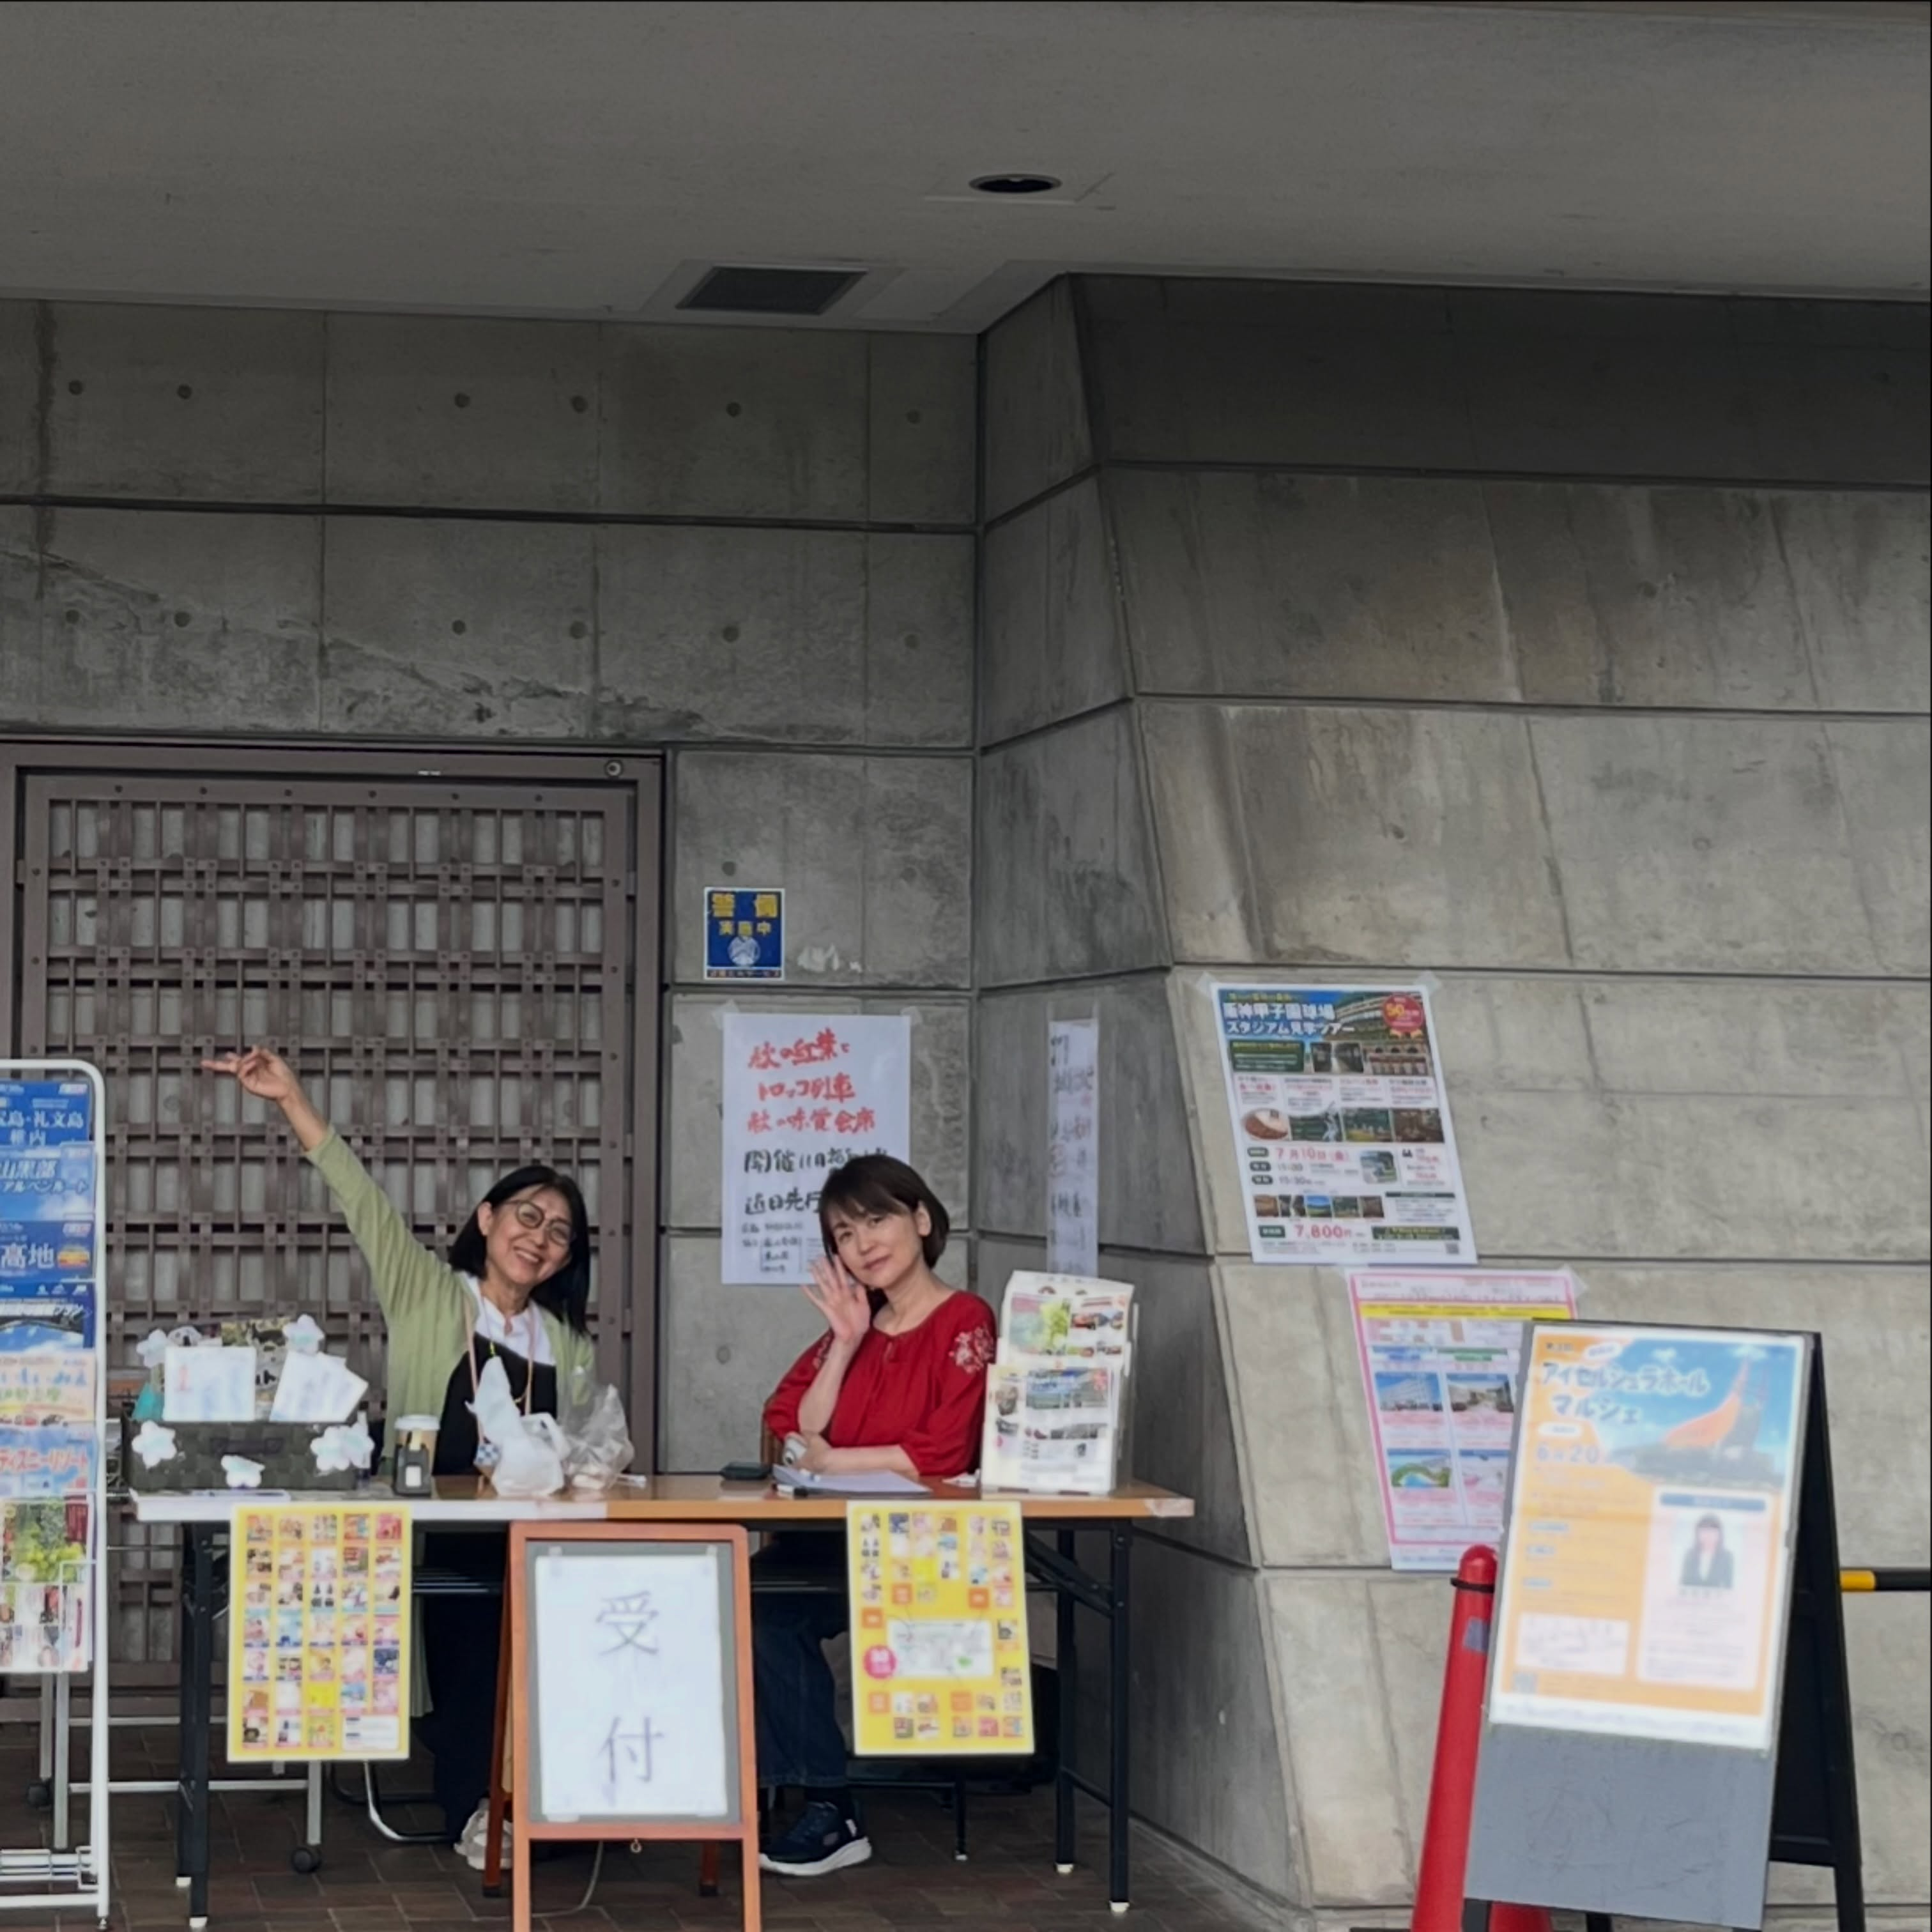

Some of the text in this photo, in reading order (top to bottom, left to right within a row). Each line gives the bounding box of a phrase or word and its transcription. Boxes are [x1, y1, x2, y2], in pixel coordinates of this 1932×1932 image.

[0, 1110, 84, 1129] 島・礼文島
[1542, 1361, 1708, 1393] アイセルシュラホール
[1552, 1394, 1640, 1424] マルシェ
[595, 1590, 665, 1784] 受付
